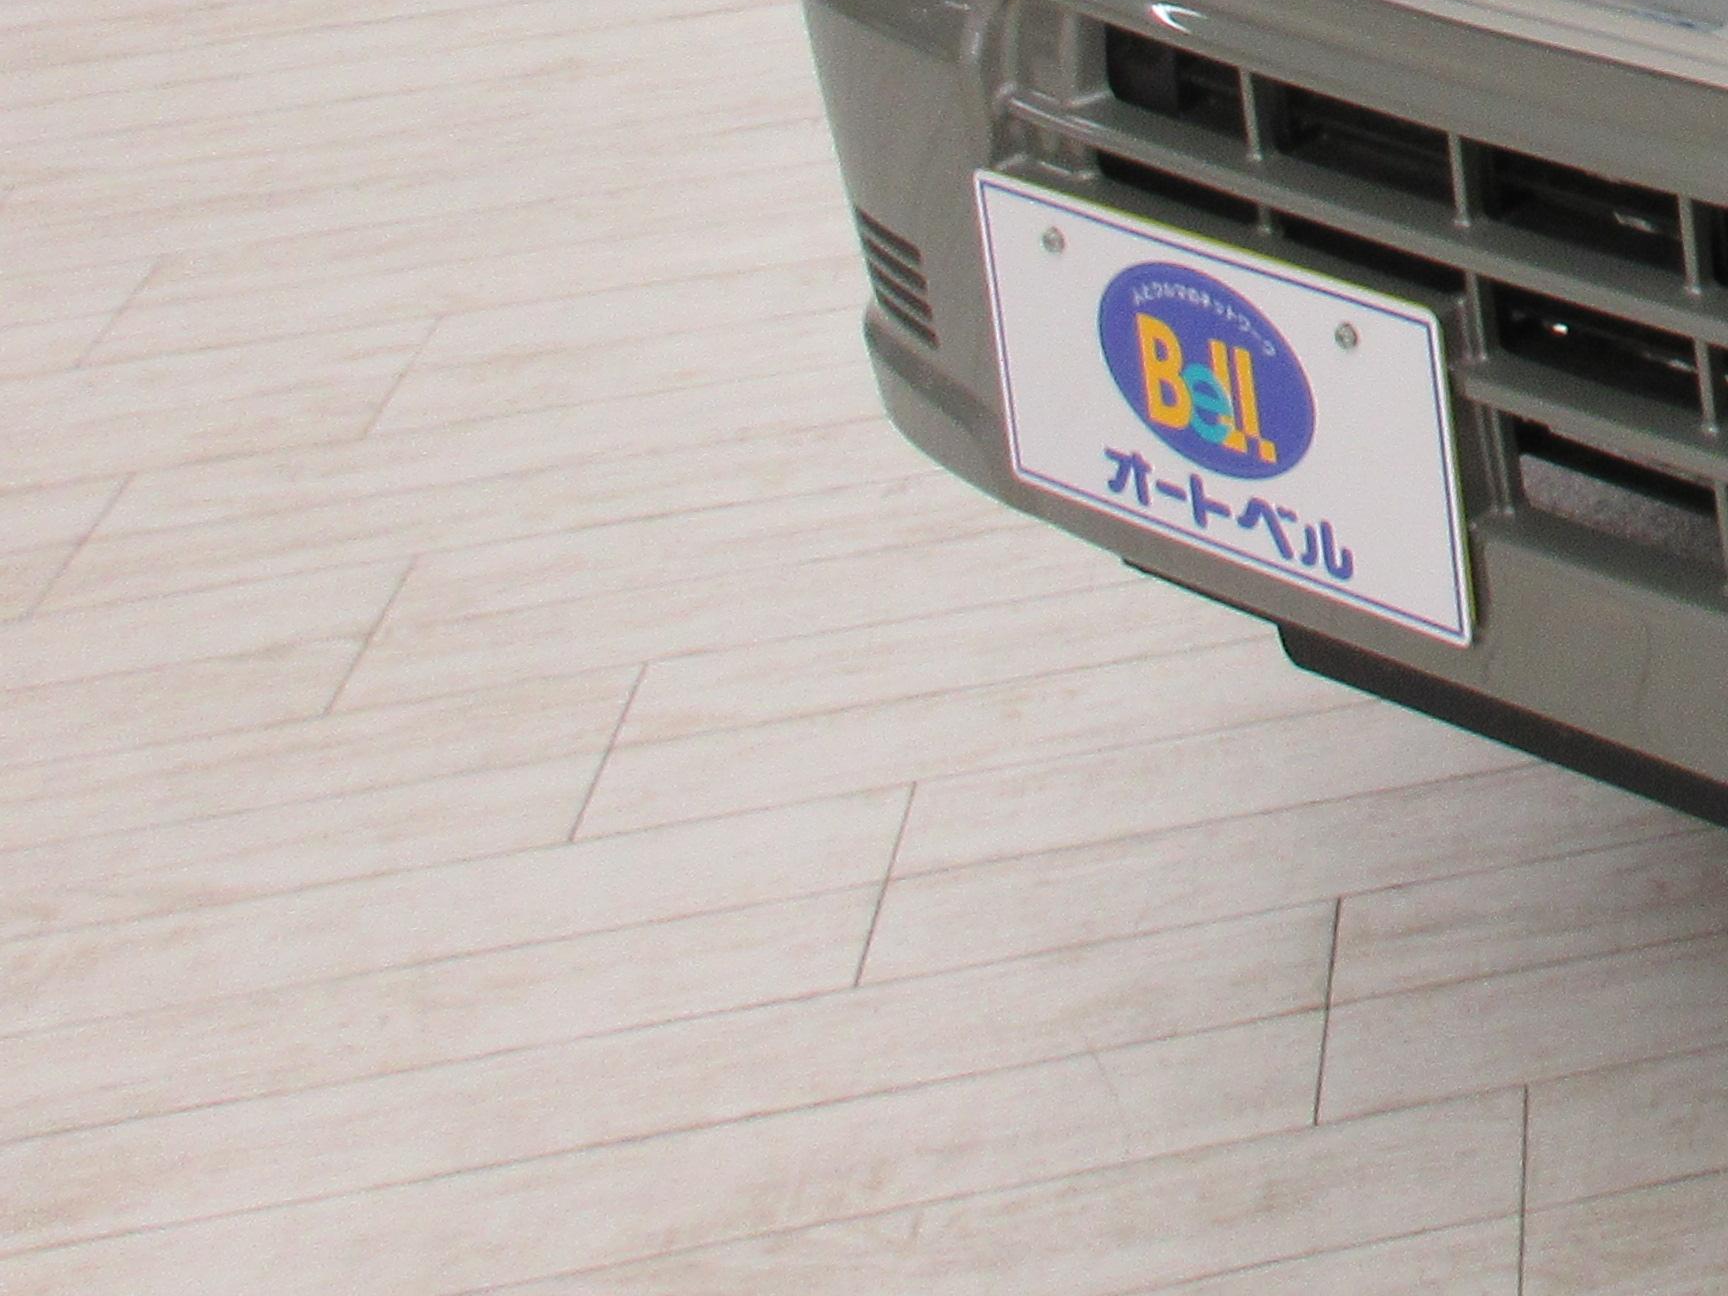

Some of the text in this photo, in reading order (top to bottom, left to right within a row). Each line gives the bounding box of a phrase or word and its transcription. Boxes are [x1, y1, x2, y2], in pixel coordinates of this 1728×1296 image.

[1104, 447, 1354, 581] オートベル
